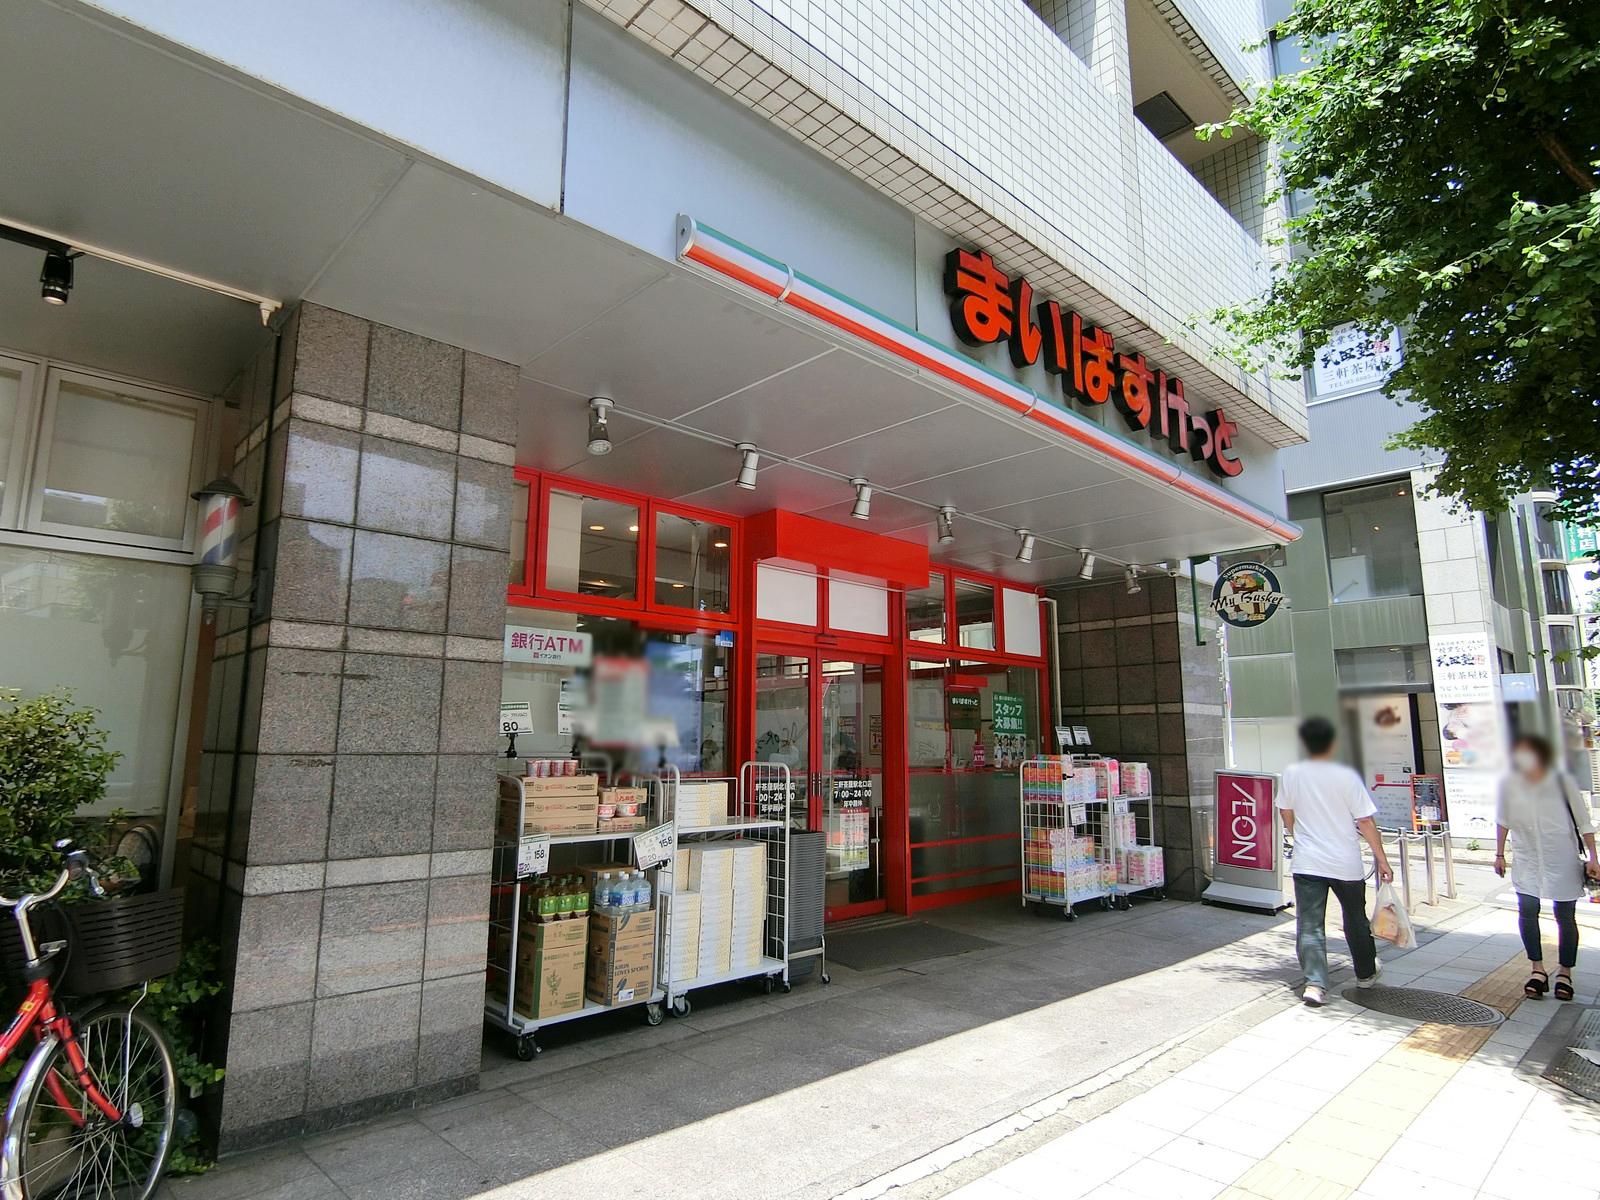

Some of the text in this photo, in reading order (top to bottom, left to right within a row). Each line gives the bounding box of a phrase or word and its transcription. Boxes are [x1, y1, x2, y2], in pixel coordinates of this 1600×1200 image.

[946, 248, 1243, 477] まいばすけっと
[1222, 564, 1267, 579] Supermarket
[1209, 591, 1283, 612] My Basket
[511, 631, 584, 653] 銀行ATM
[951, 697, 978, 706] まいばすけっと
[994, 703, 1022, 716] スタッフ
[502, 721, 519, 732] 80
[834, 780, 873, 789] 三軒茶屋駅北口店
[1231, 782, 1257, 861] AEON
[659, 836, 673, 848] 158
[534, 849, 545, 860] 158
[614, 968, 630, 977] LOVES
